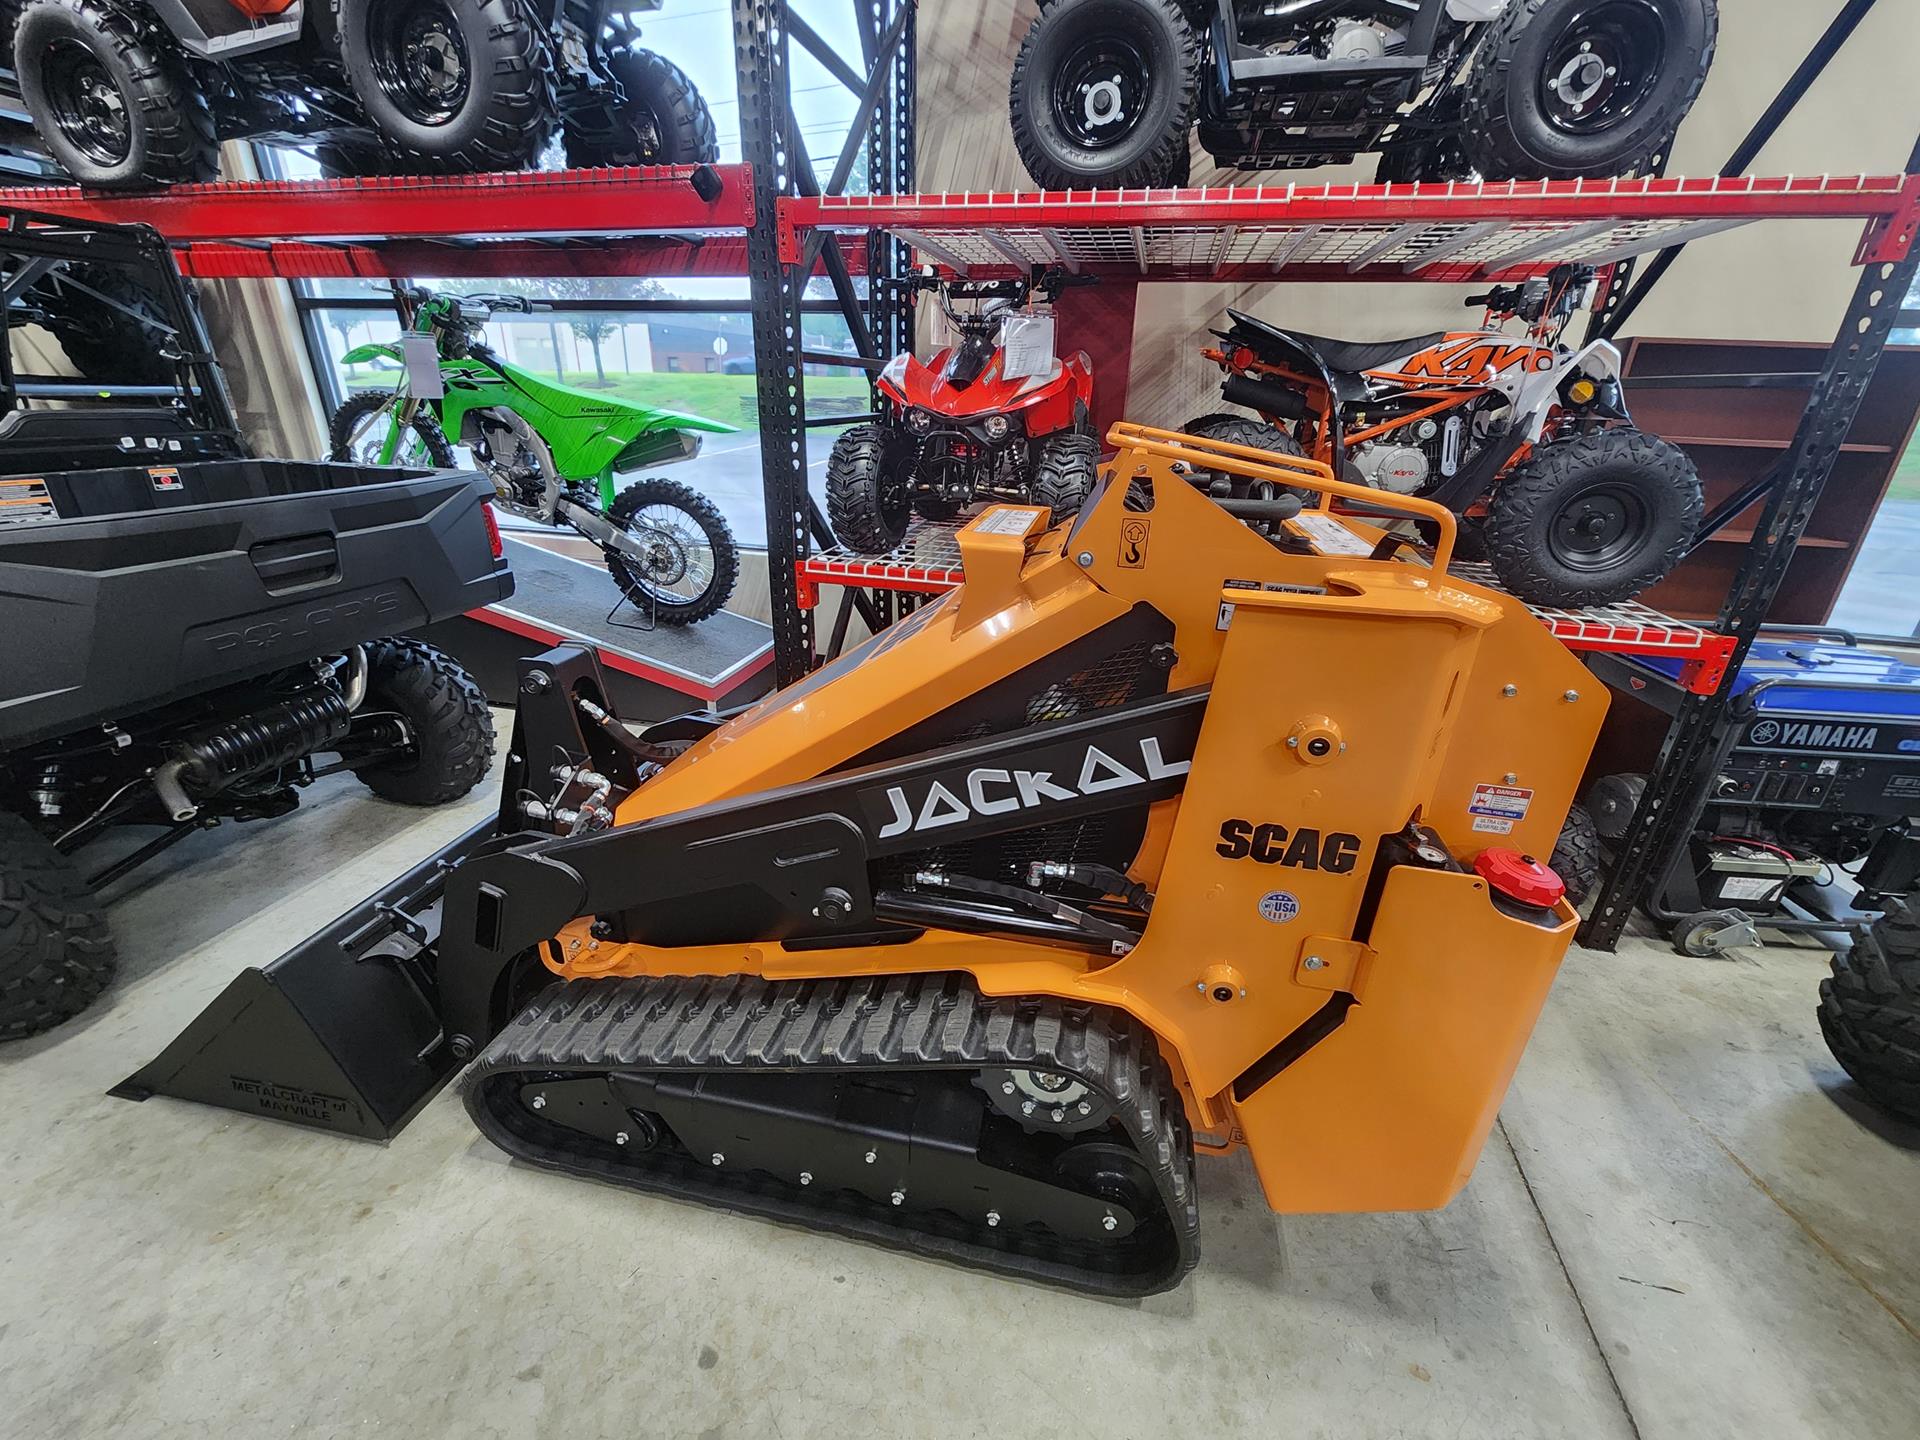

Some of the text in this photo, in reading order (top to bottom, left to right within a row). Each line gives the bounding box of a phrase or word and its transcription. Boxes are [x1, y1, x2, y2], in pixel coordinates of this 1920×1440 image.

[1399, 338, 1554, 386] KAYO
[580, 406, 615, 414] Kawasaki
[204, 591, 398, 650] POLARIS
[1779, 722, 1878, 749] YAMAHA
[878, 736, 1193, 839] JACKAL
[1496, 788, 1523, 797] DANGER
[1215, 818, 1362, 874] SCAG
[1274, 902, 1296, 913] USA
[231, 1081, 347, 1113] METALCRAFT of
[259, 1098, 331, 1121] MAYVILLE
